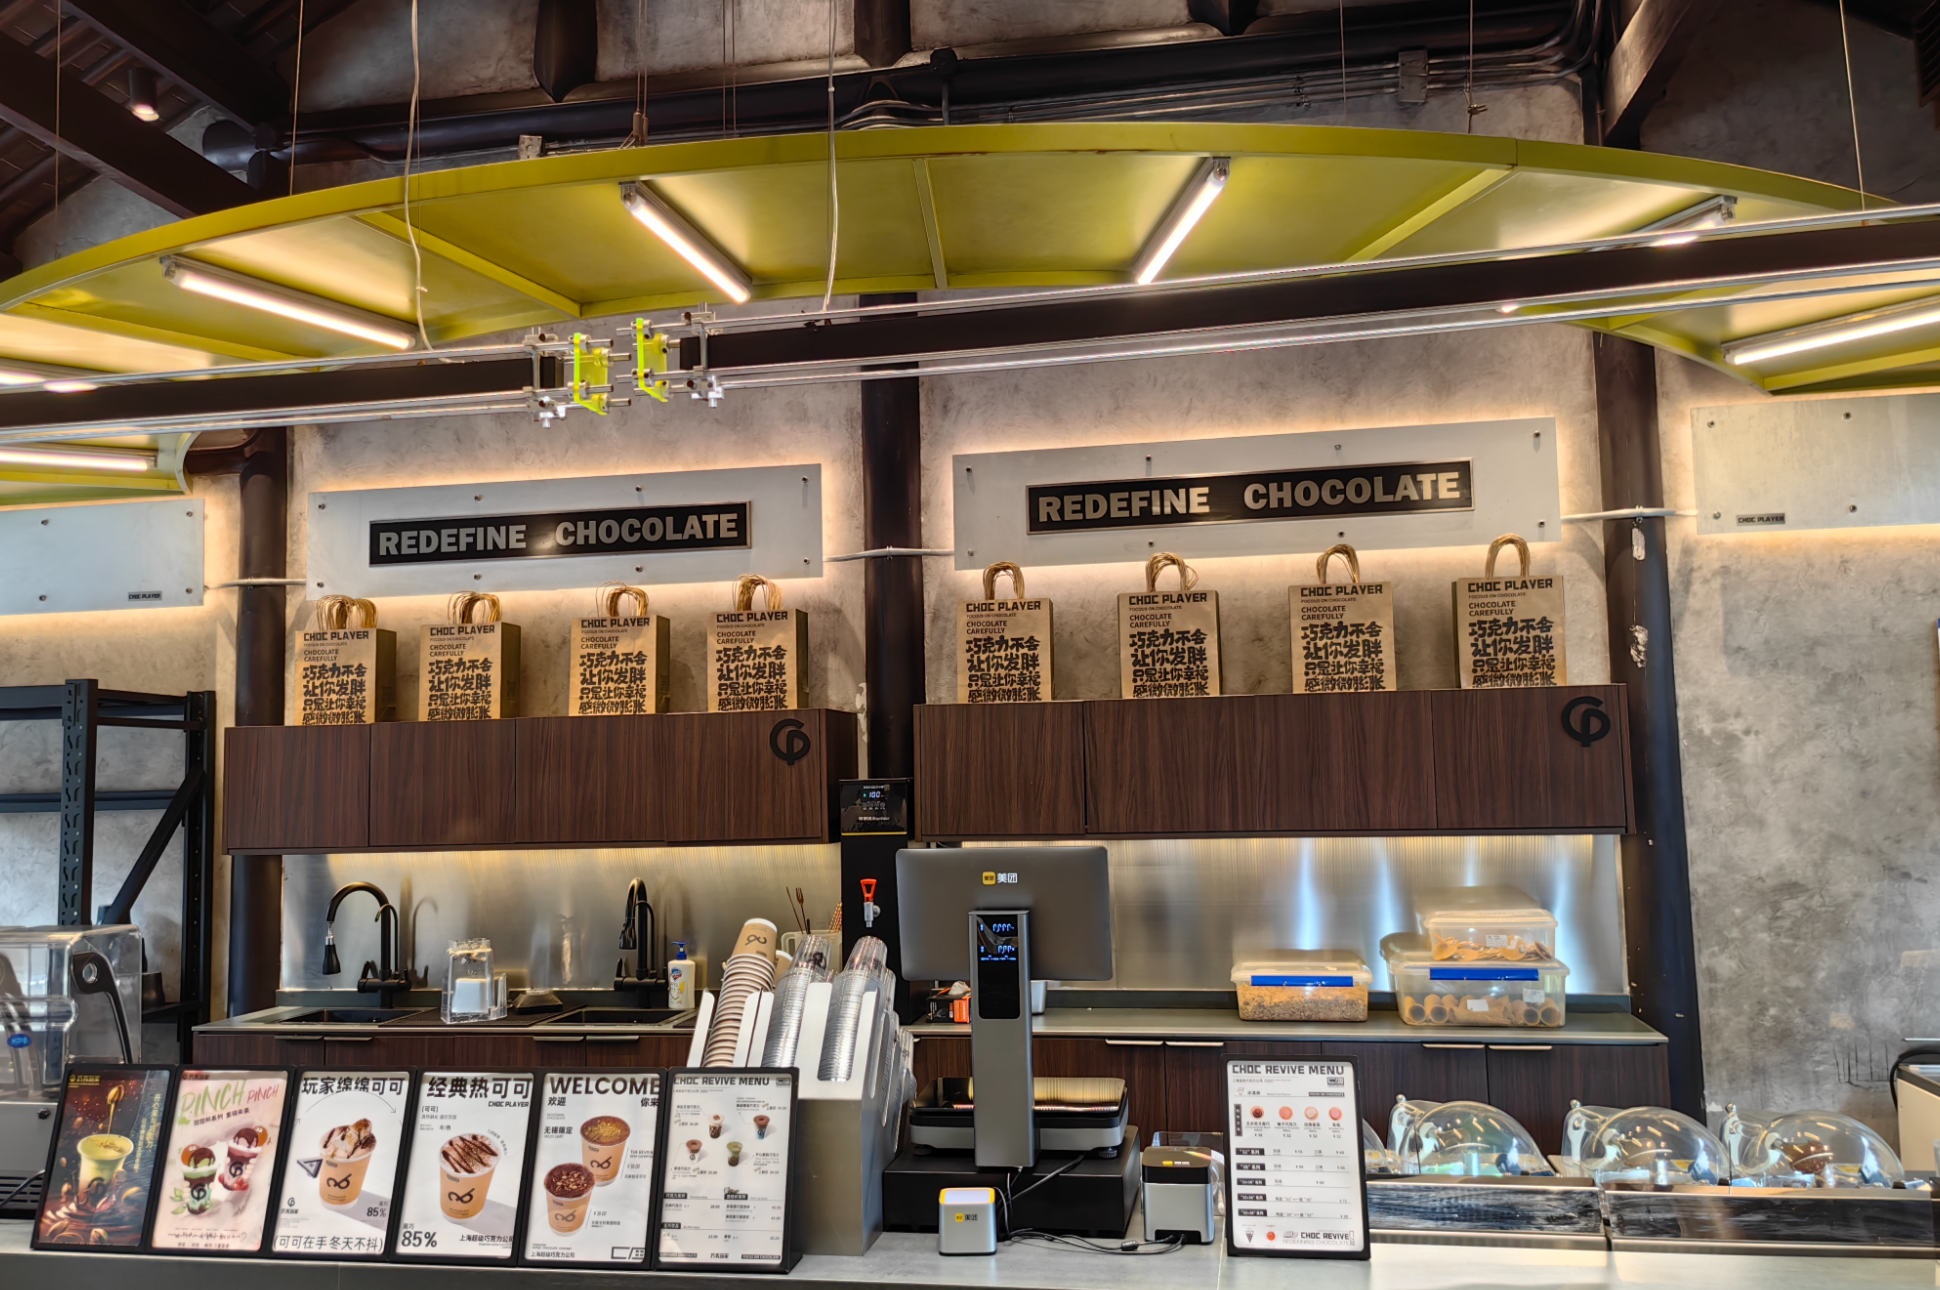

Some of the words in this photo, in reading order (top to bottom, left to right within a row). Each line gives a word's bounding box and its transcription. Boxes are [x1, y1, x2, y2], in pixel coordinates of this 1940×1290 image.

[1038, 486, 1210, 522] REDEFINE
[1244, 472, 1460, 510] CHOCOLATE
[378, 524, 528, 556] REDEFINE
[554, 512, 738, 546] CHOCOLATE
[1301, 587, 1332, 597] CHOC
[1336, 584, 1382, 596] PLAYER
[1468, 582, 1500, 592] CHOC
[1505, 579, 1552, 590] PLAYER
[966, 603, 994, 612] CHOC
[998, 601, 1041, 611] PLAYER
[1129, 595, 1159, 605] CHOC
[1162, 593, 1207, 604] PLAYER
[1469, 601, 1516, 609] CHOCOLATE
[581, 619, 607, 628] CHOC
[610, 618, 650, 628] PLAYER
[716, 614, 744, 622] CHOC
[747, 612, 788, 622] PLAYER
[304, 632, 328, 641] CHOC
[331, 630, 369, 640] PLAYER
[430, 627, 454, 636] CHOC
[458, 625, 495, 635] PLAYER
[1302, 638, 1382, 660] 让你发胖
[1470, 634, 1554, 657] 让你发胖
[967, 652, 1039, 672] 让你发胖
[1131, 646, 1207, 668] 让你发胖
[1472, 654, 1556, 674] 只是让你幸福
[717, 661, 786, 681] 让你发胖
[1132, 665, 1208, 683] 只是让你幸福
[1304, 658, 1384, 676] 只是让你幸福
[428, 673, 491, 692] 让你发胖
[580, 666, 646, 686] 让你发胖
[968, 670, 1041, 688] 只是让你幸福
[303, 678, 366, 697] 让你发胖
[579, 684, 646, 700] 只是让你幸福
[718, 679, 787, 696] 只是让你幸福
[303, 696, 366, 712] 只是让你幸福
[428, 690, 492, 706] 只是让你幸福
[997, 873, 1018, 884] 美团
[1232, 1065, 1261, 1074] CHOC
[1266, 1066, 1304, 1074] REVIVE
[1309, 1066, 1344, 1075] MENU
[301, 1077, 405, 1095] 玩家绵绵可可
[427, 1076, 532, 1099] 经典热可可
[550, 1077, 660, 1094] WELCOME
[702, 1077, 736, 1086] REVIVE
[739, 1077, 770, 1086] MENU
[182, 1079, 246, 1117] PINCH
[247, 1084, 280, 1103] PINCH
[548, 1096, 566, 1106] 欢迎
[367, 1207, 387, 1218] 85%
[274, 1236, 384, 1252] (可可在手冬天不抖)
[402, 1231, 437, 1248] 85%
[459, 1234, 514, 1243] 上海超级巧克力公司
[1323, 1232, 1349, 1240] REVIVE
